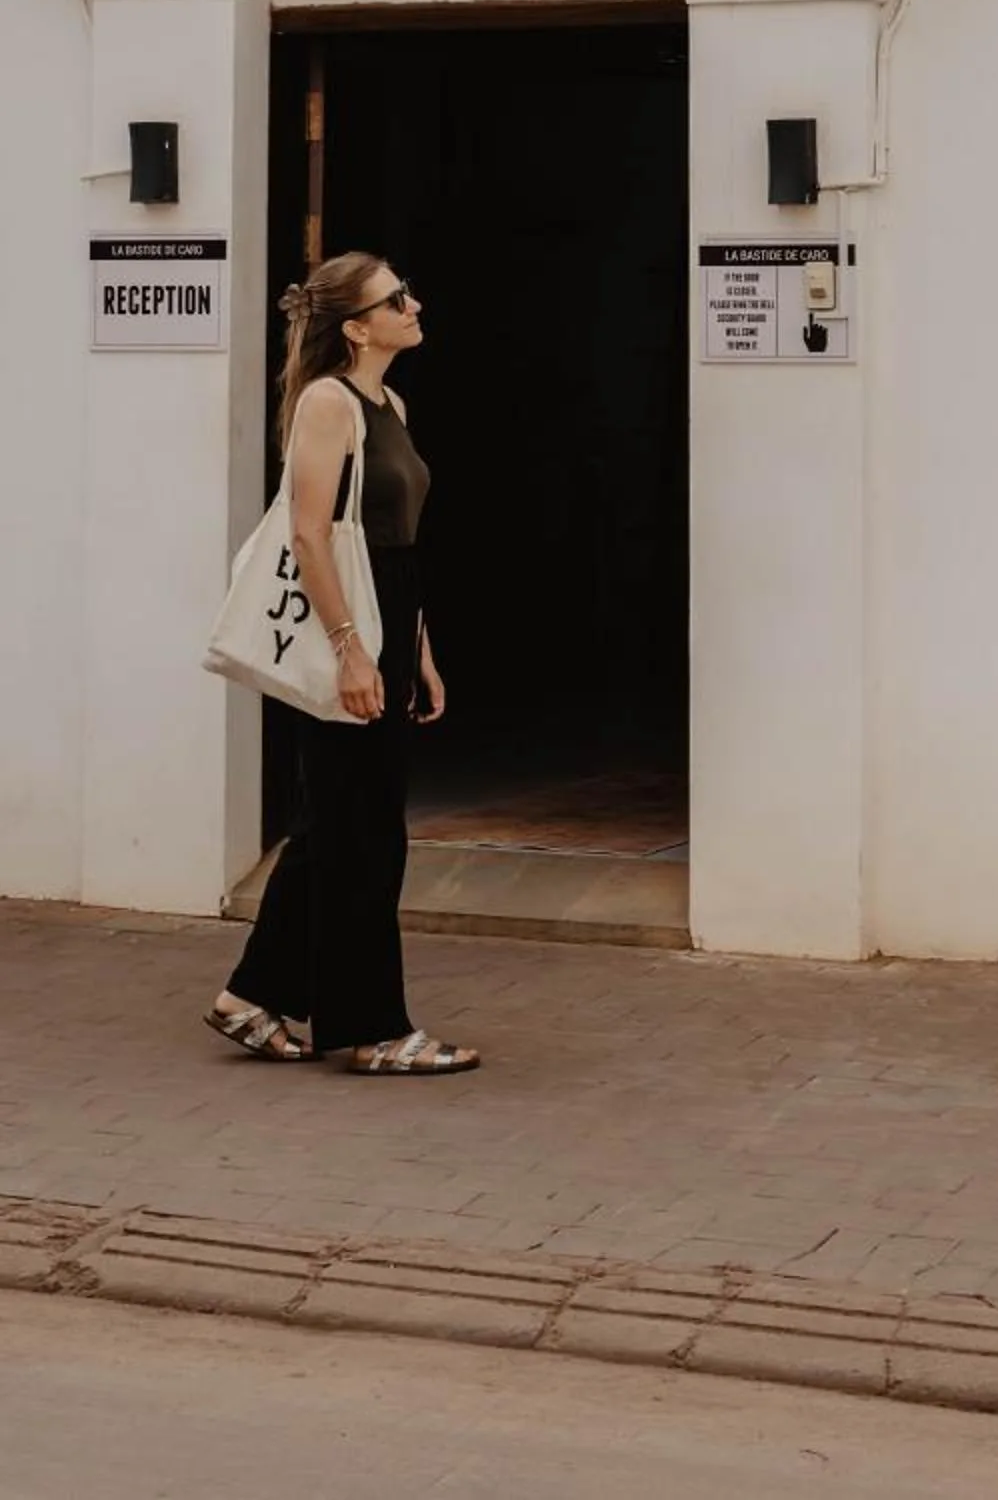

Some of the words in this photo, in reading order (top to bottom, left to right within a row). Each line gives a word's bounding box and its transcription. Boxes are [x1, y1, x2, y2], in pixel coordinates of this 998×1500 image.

[111, 245, 124, 256] LA
[164, 245, 176, 256] DE
[725, 250, 738, 261] LA
[740, 250, 783, 261] BASTIDE
[785, 250, 798, 260] DE
[801, 249, 829, 260] CARO
[103, 285, 211, 315] RECEPTION
[273, 630, 294, 664] Y
